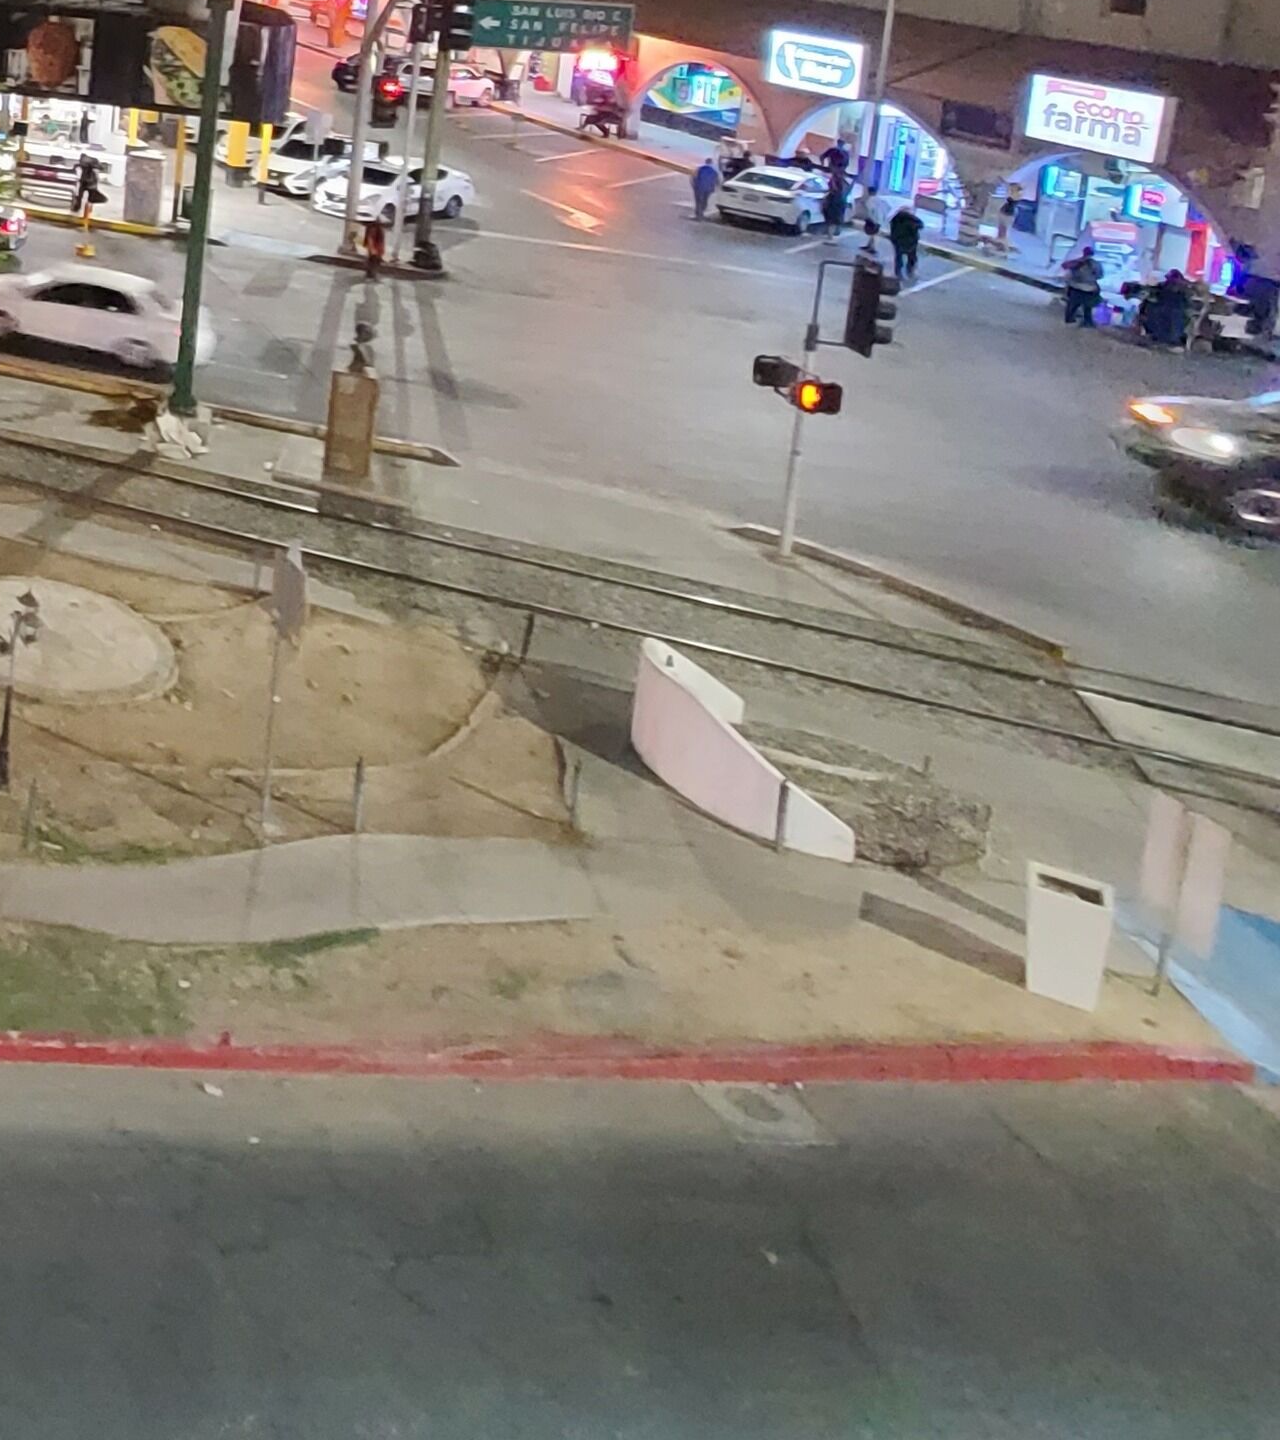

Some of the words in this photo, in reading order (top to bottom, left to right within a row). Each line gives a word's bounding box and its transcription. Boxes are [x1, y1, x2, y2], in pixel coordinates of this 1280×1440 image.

[511, 5, 540, 17] SAN
[509, 19, 543, 32] SAN
[1073, 100, 1144, 124] econo
[1043, 103, 1142, 146] farma
